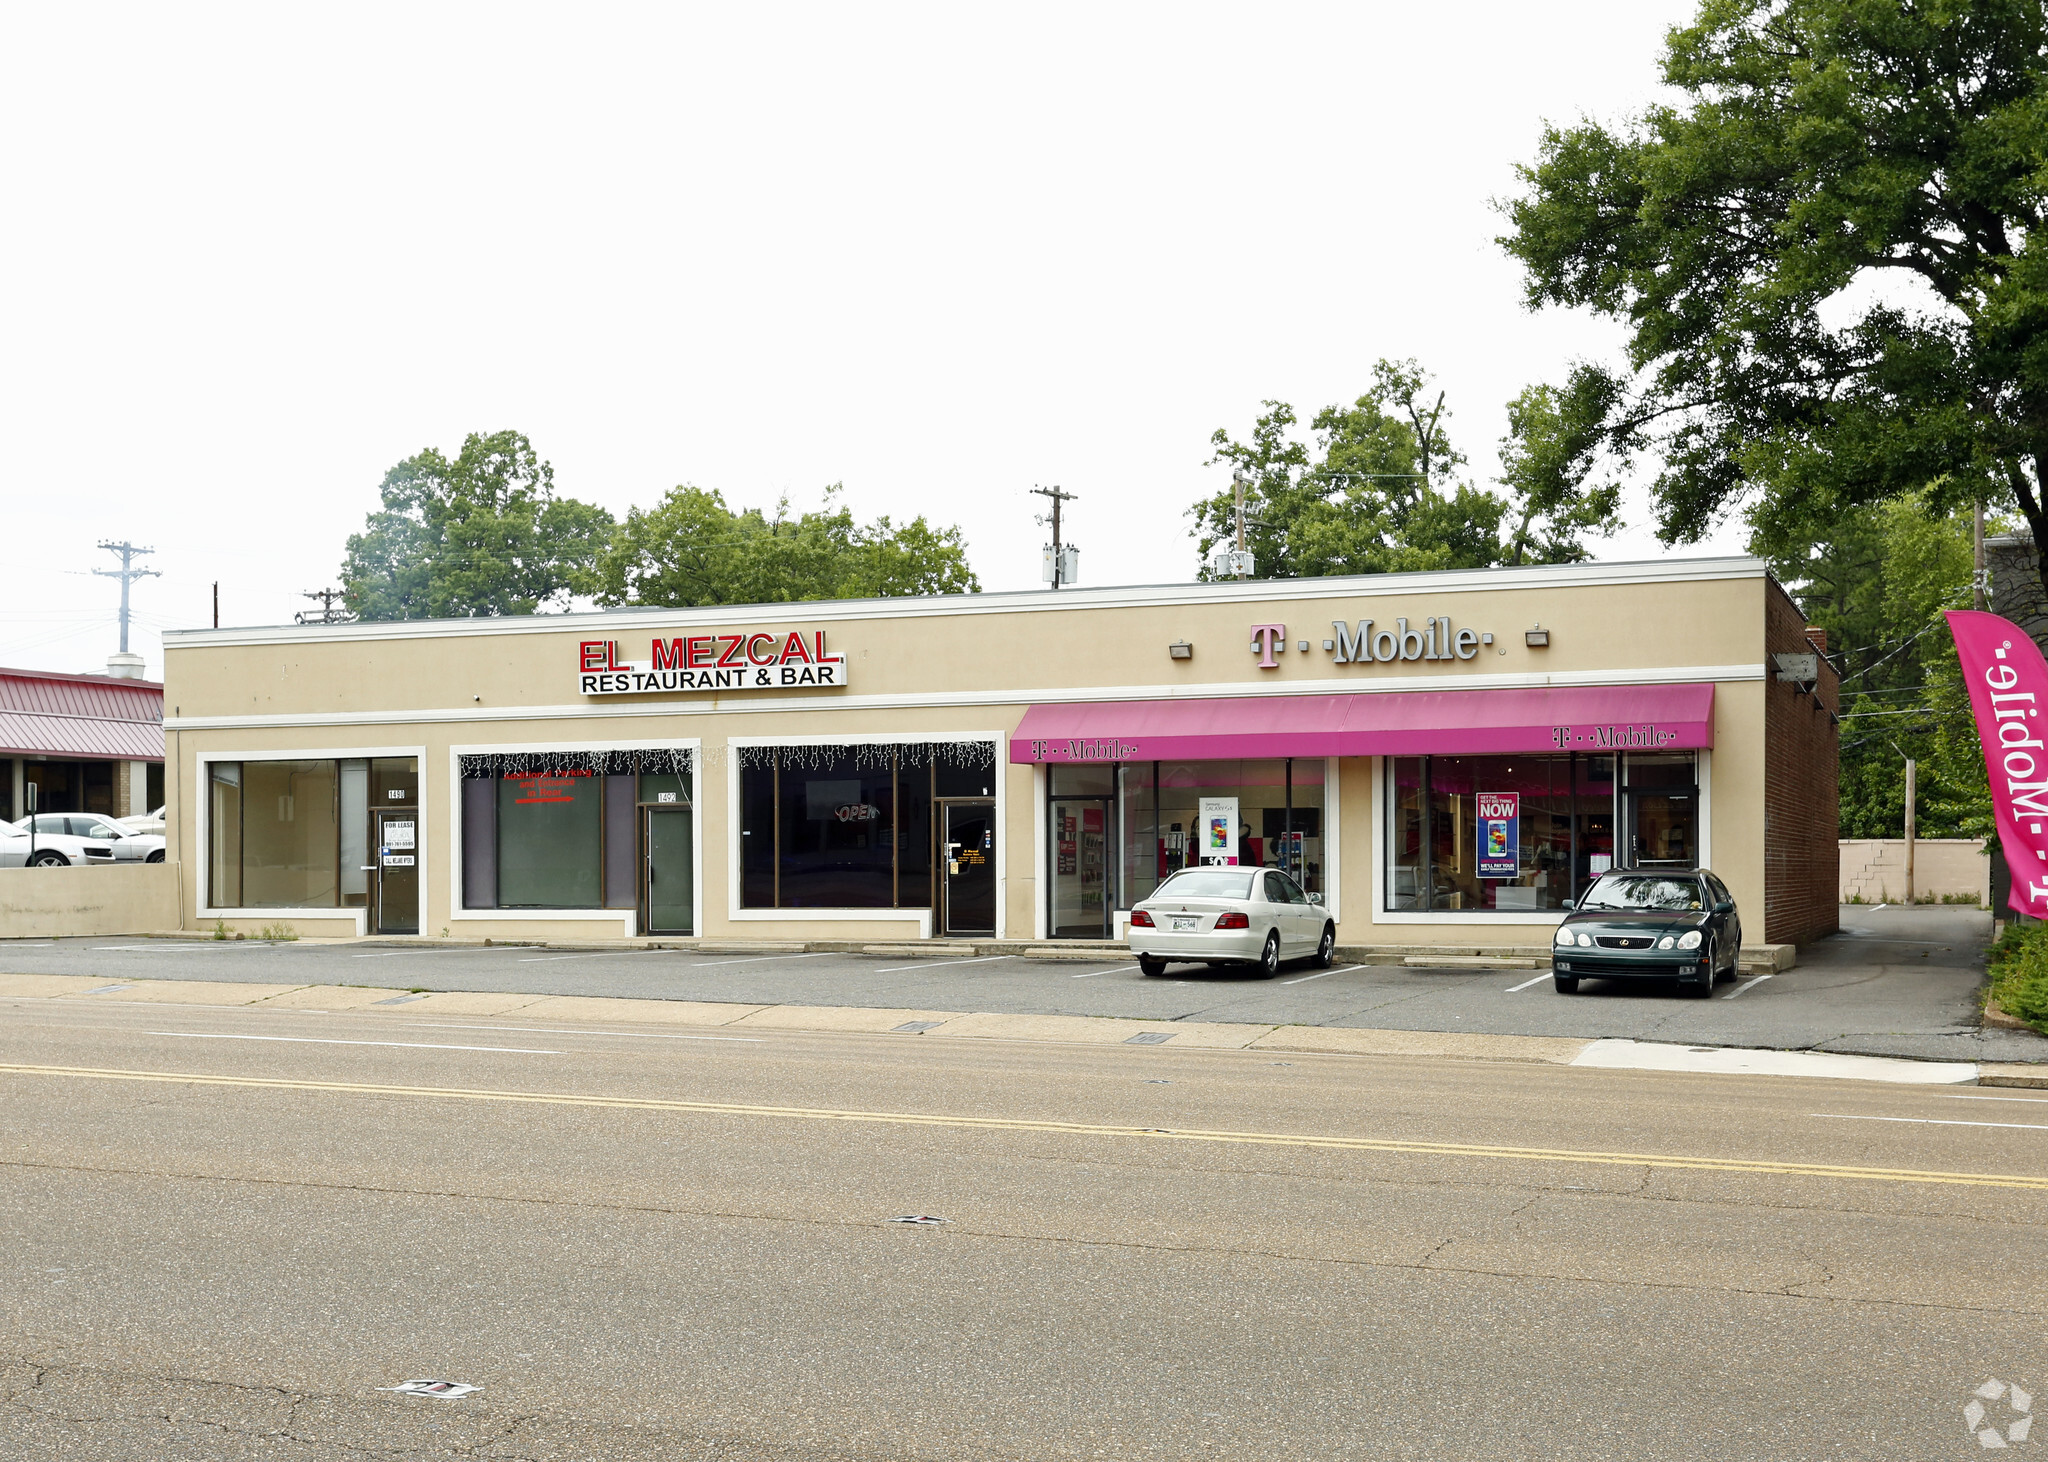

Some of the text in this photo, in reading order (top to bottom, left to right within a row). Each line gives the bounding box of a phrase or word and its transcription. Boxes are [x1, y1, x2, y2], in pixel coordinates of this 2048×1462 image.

[1332, 616, 1478, 663] Mobile
[579, 630, 844, 673] EL MEZCAL
[582, 666, 835, 693] RESTAURANT & BAR
[1595, 725, 1668, 748] Mobile
[1068, 739, 1130, 760] Mobile
[504, 768, 592, 780] Additional Parking
[520, 778, 576, 788] and Entrance
[527, 787, 562, 797] in Rear
[659, 792, 676, 802] 1492
[840, 804, 876, 822] OPEN
[1480, 803, 1515, 817] NOW
